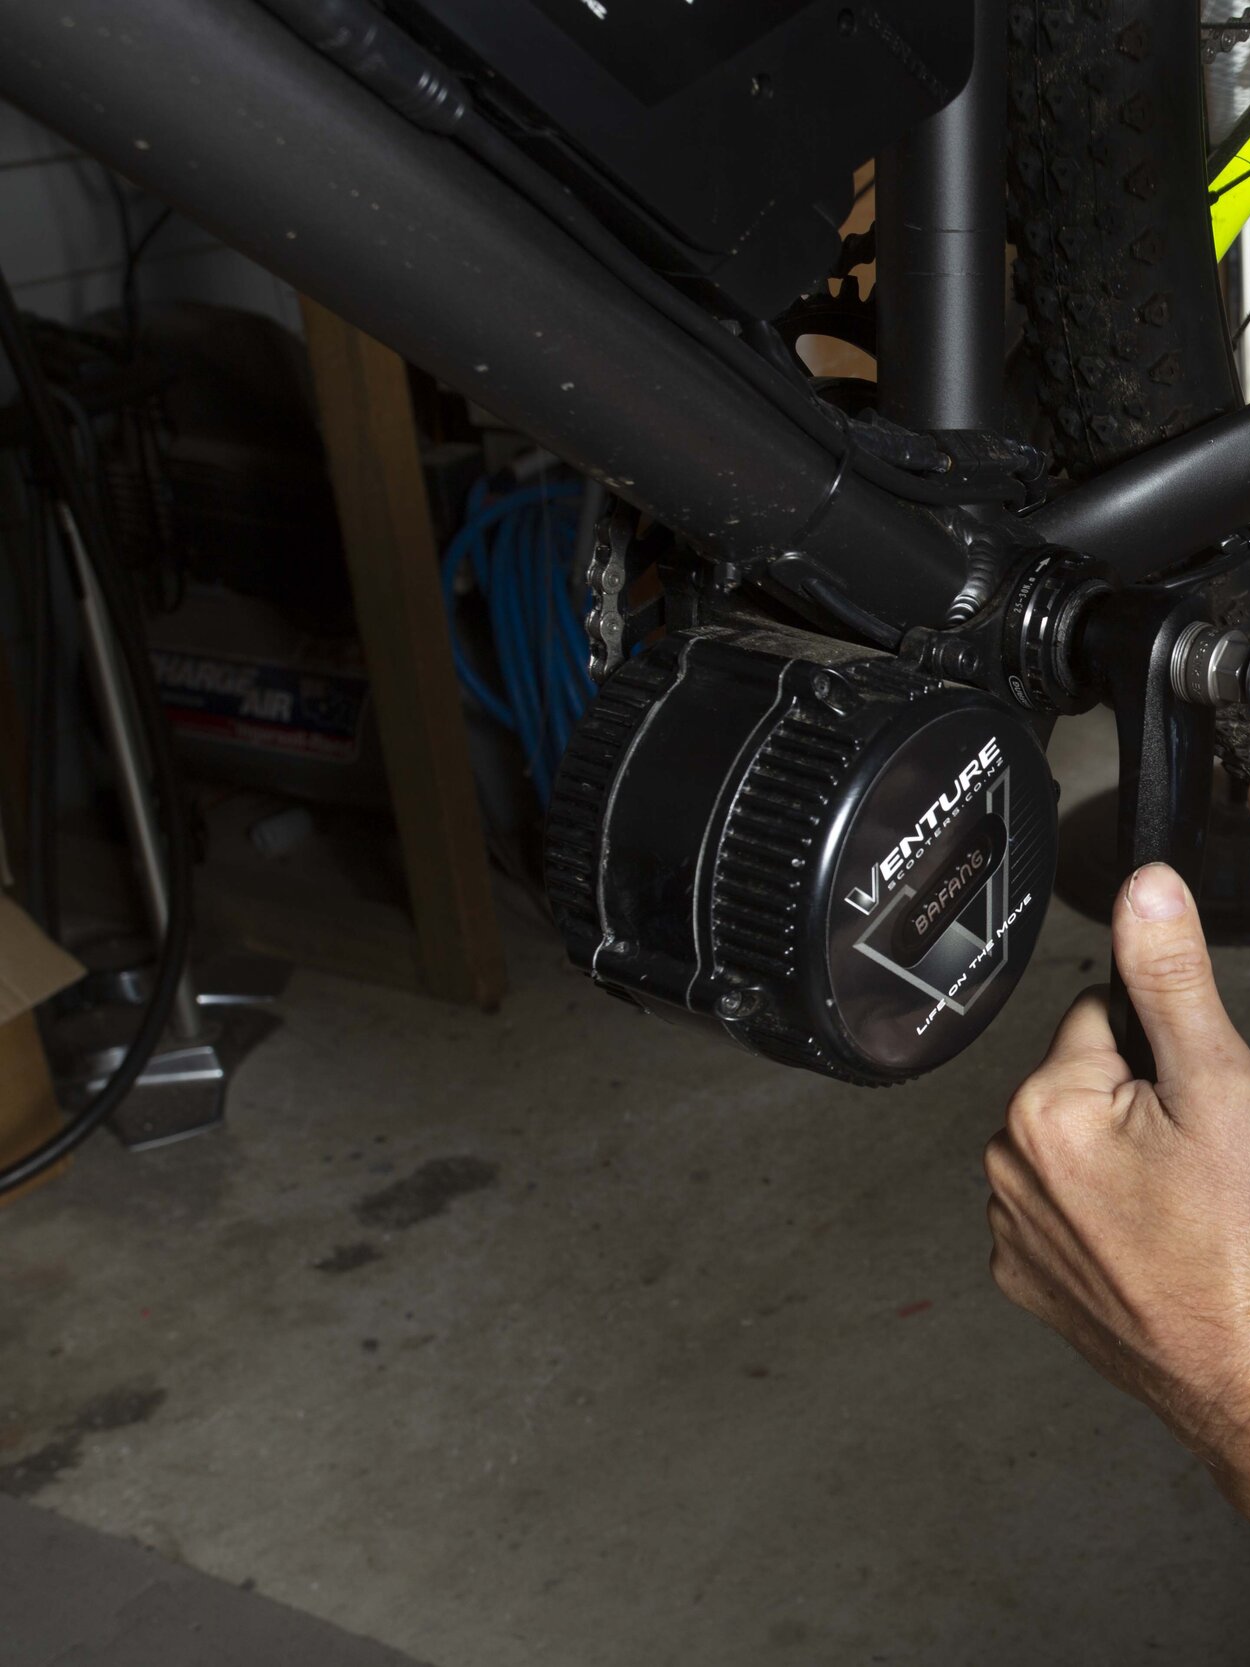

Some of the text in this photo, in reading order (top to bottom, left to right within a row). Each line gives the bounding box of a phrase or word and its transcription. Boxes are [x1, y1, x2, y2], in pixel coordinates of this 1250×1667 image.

[239, 686, 296, 723] AIR
[844, 736, 1000, 916] VENTURE
[914, 849, 984, 936] BAFANG
[916, 893, 1032, 1035] LIFE ON THE MOVE
